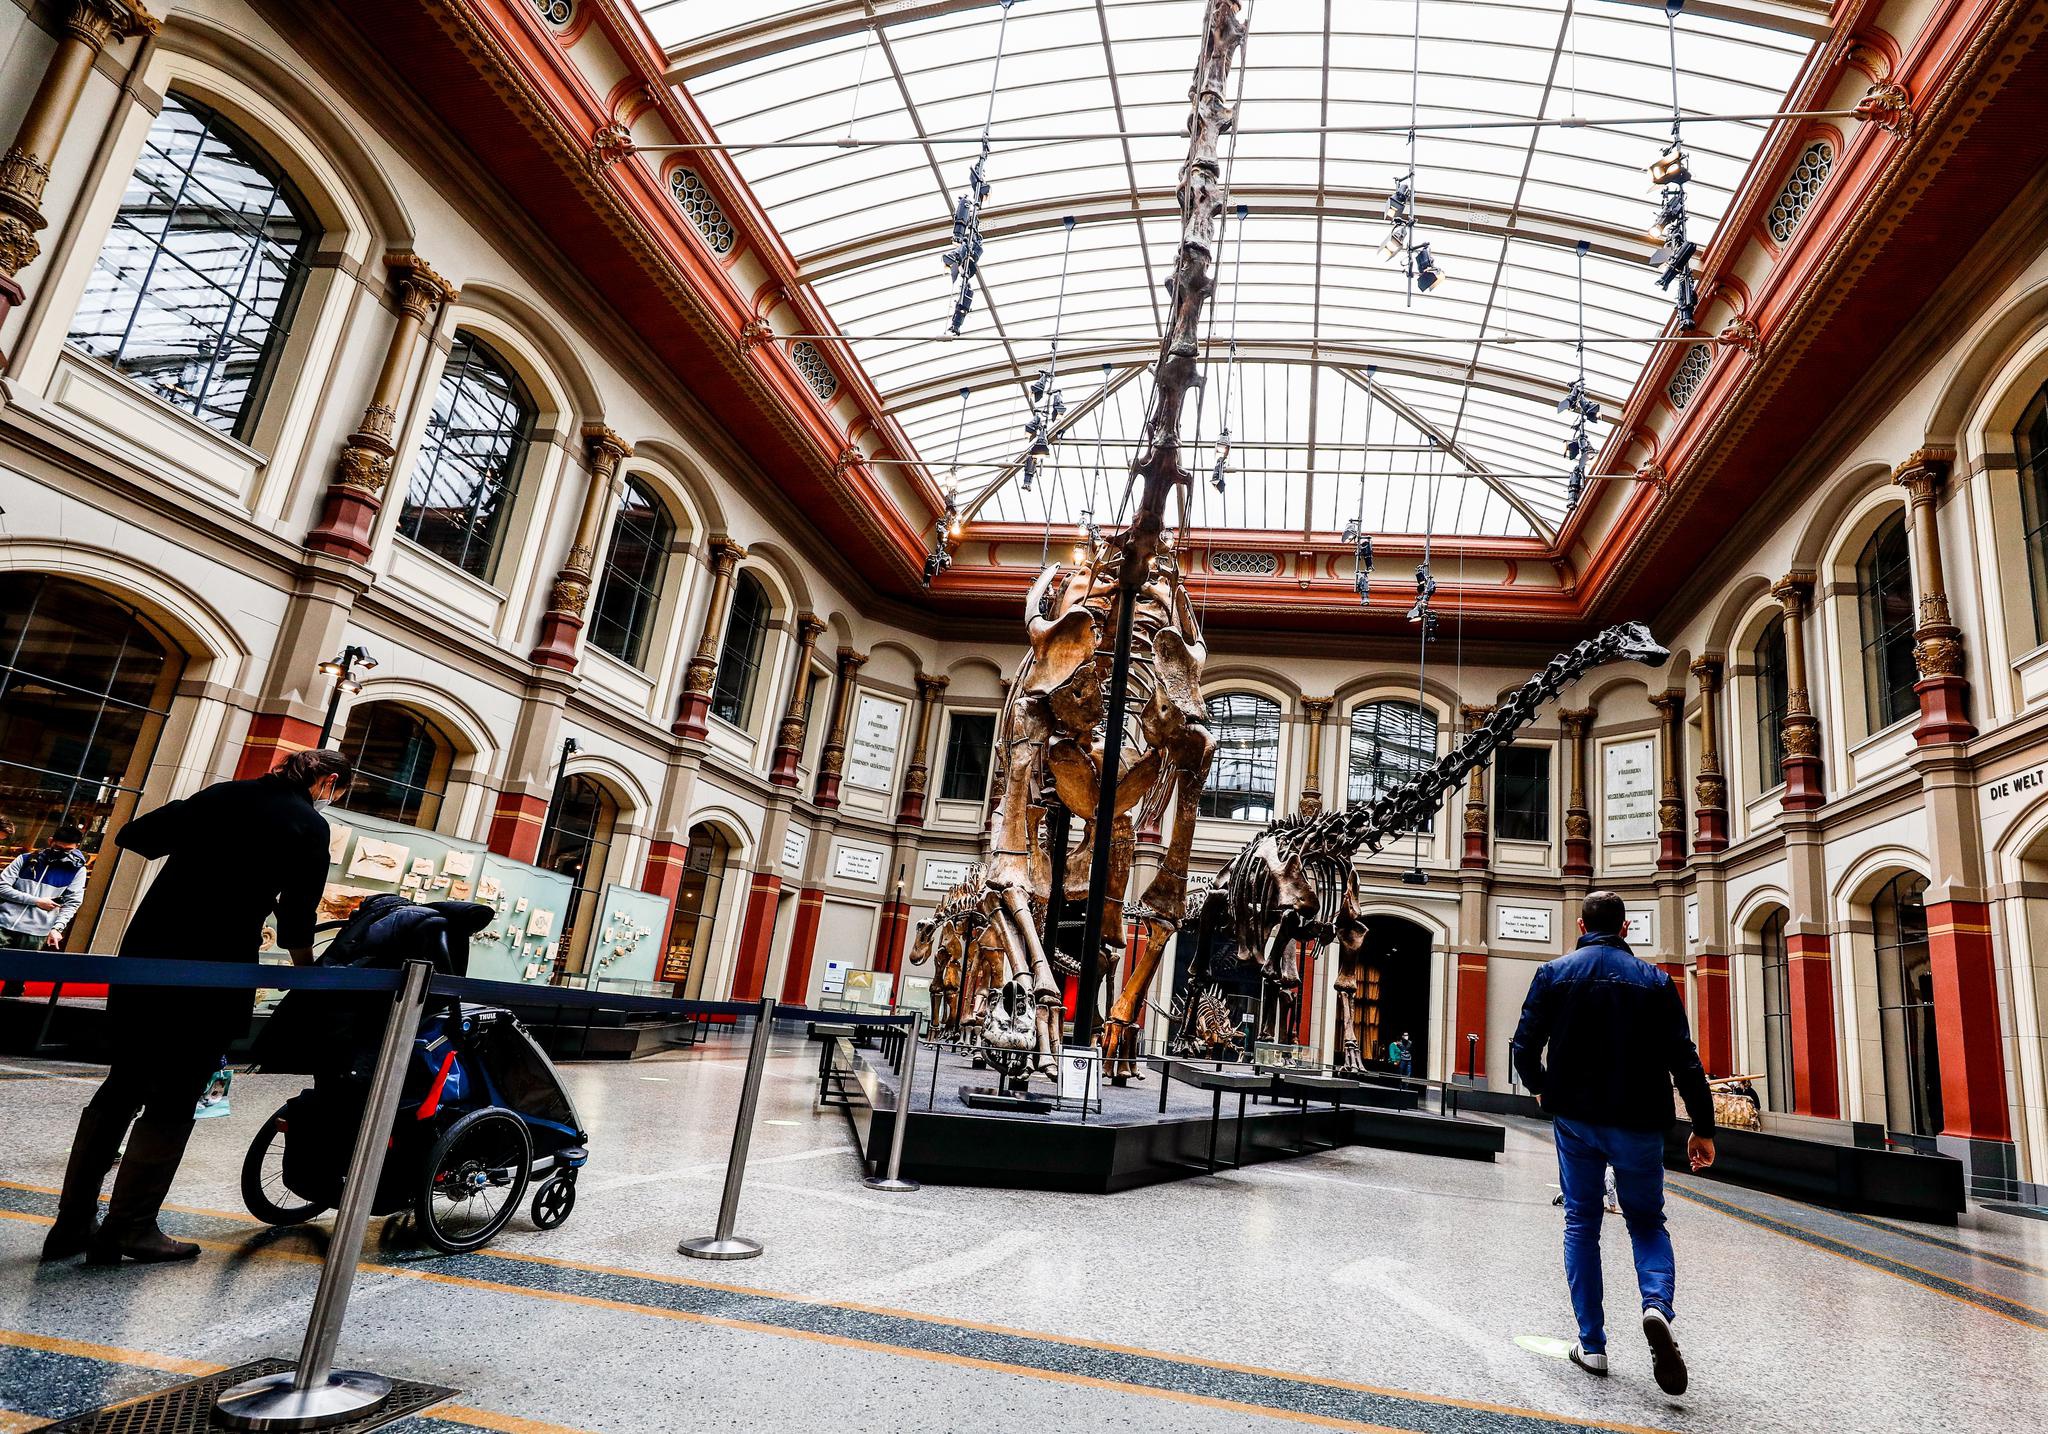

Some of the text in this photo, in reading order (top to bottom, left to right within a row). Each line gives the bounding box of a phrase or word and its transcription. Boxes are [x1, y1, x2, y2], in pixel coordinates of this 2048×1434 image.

[1990, 770, 2044, 801] DIE WELT
[479, 1012, 497, 1021] THULE
